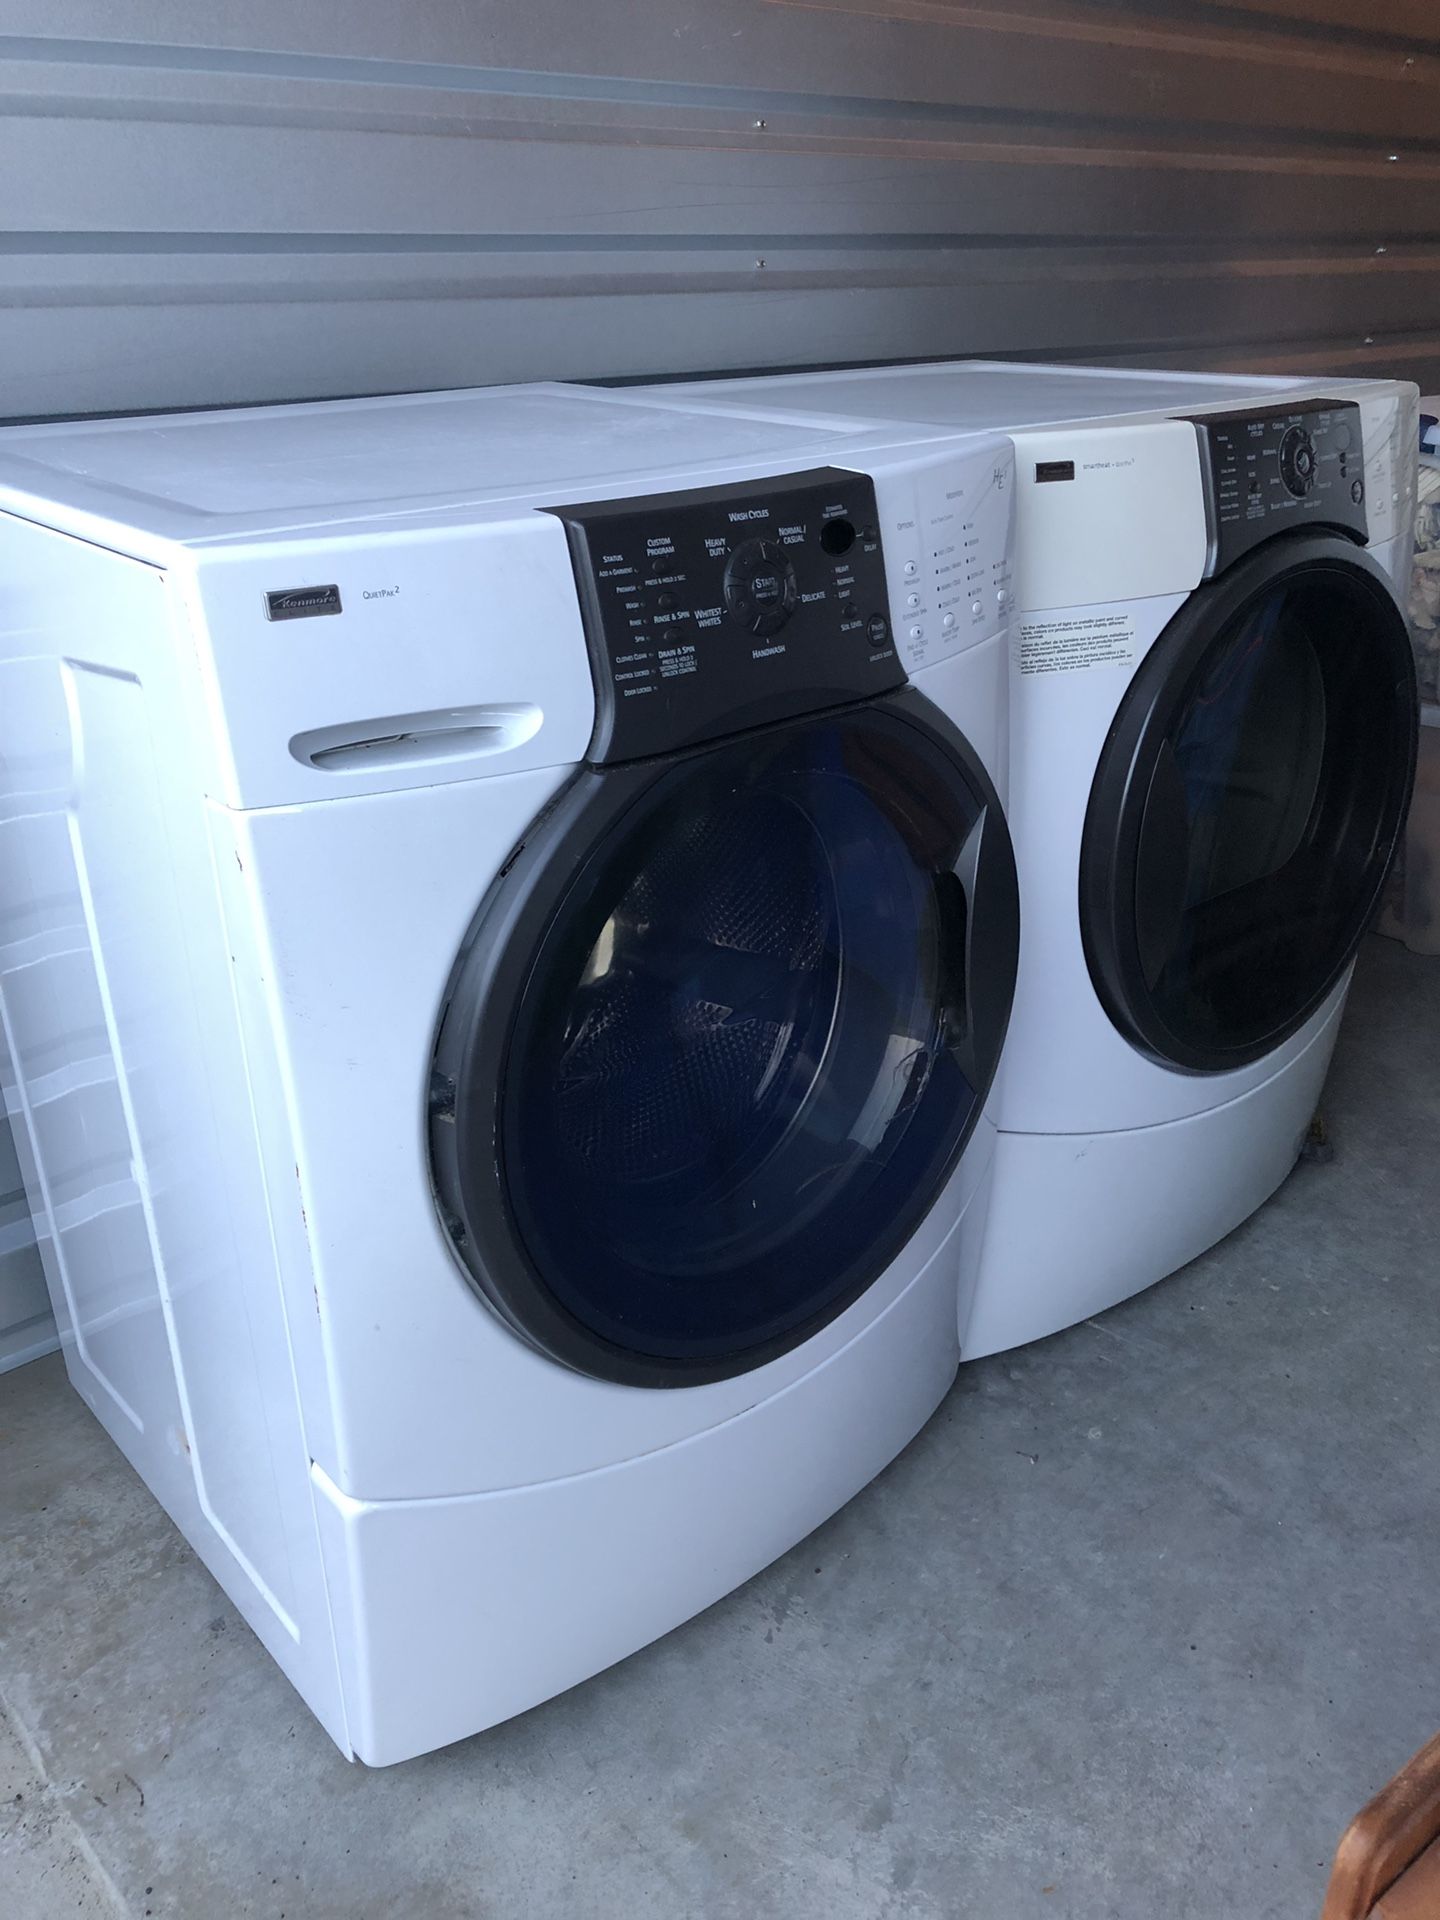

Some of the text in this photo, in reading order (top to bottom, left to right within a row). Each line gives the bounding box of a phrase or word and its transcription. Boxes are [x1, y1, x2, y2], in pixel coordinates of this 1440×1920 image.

[748, 509, 770, 519] CYCLES
[647, 537, 671, 547] CUSTOM
[704, 538, 726, 548] HEAVY
[783, 534, 805, 545] CASUAL
[646, 545, 675, 557] PROGRAM
[709, 547, 726, 557] DUTY
[282, 596, 336, 608] Kenmore
[801, 591, 826, 602] DELICATE
[677, 610, 690, 619] SPIN
[694, 607, 722, 619] WHITEST
[698, 617, 722, 628] WHITES
[658, 649, 677, 659] DRAIN
[752, 645, 786, 659] HANDWASH
